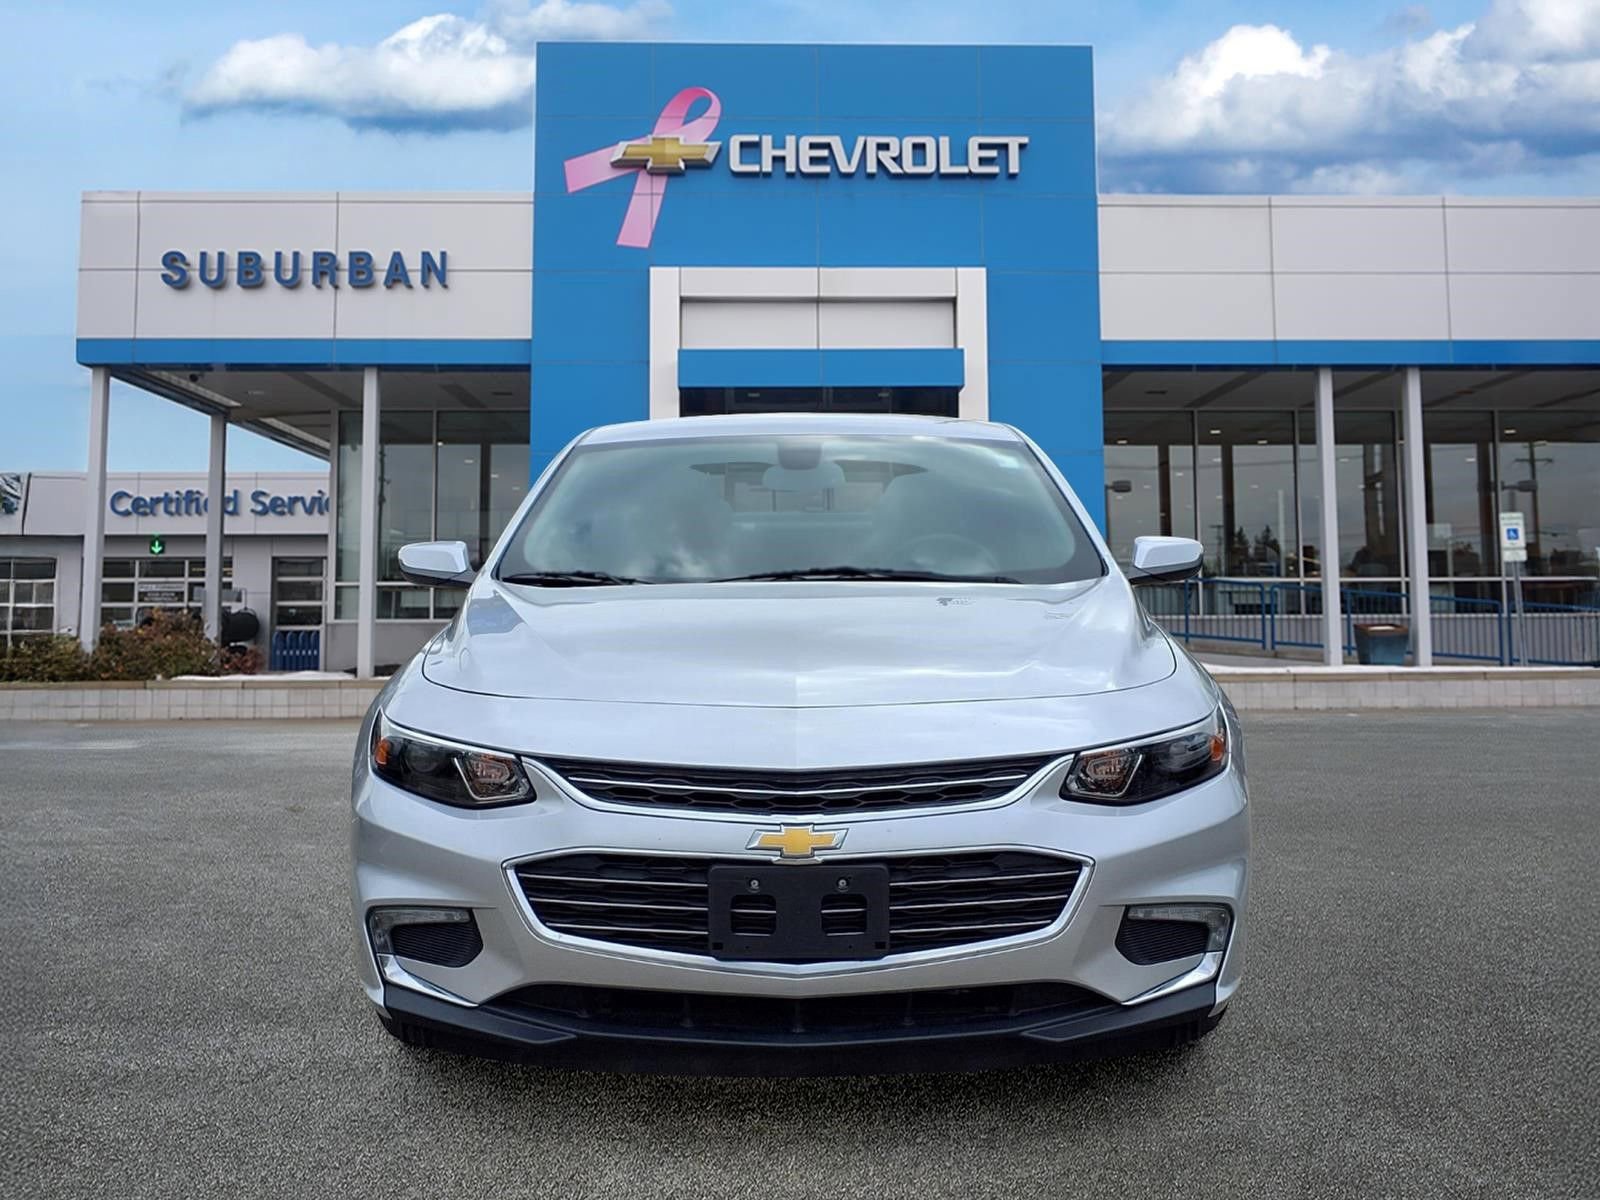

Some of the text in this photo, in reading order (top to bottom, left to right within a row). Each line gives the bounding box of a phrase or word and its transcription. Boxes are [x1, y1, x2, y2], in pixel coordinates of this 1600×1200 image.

[729, 134, 1029, 176] CHEVROLET
[161, 250, 449, 289] SUBURBAN
[110, 489, 240, 517] Certifid
